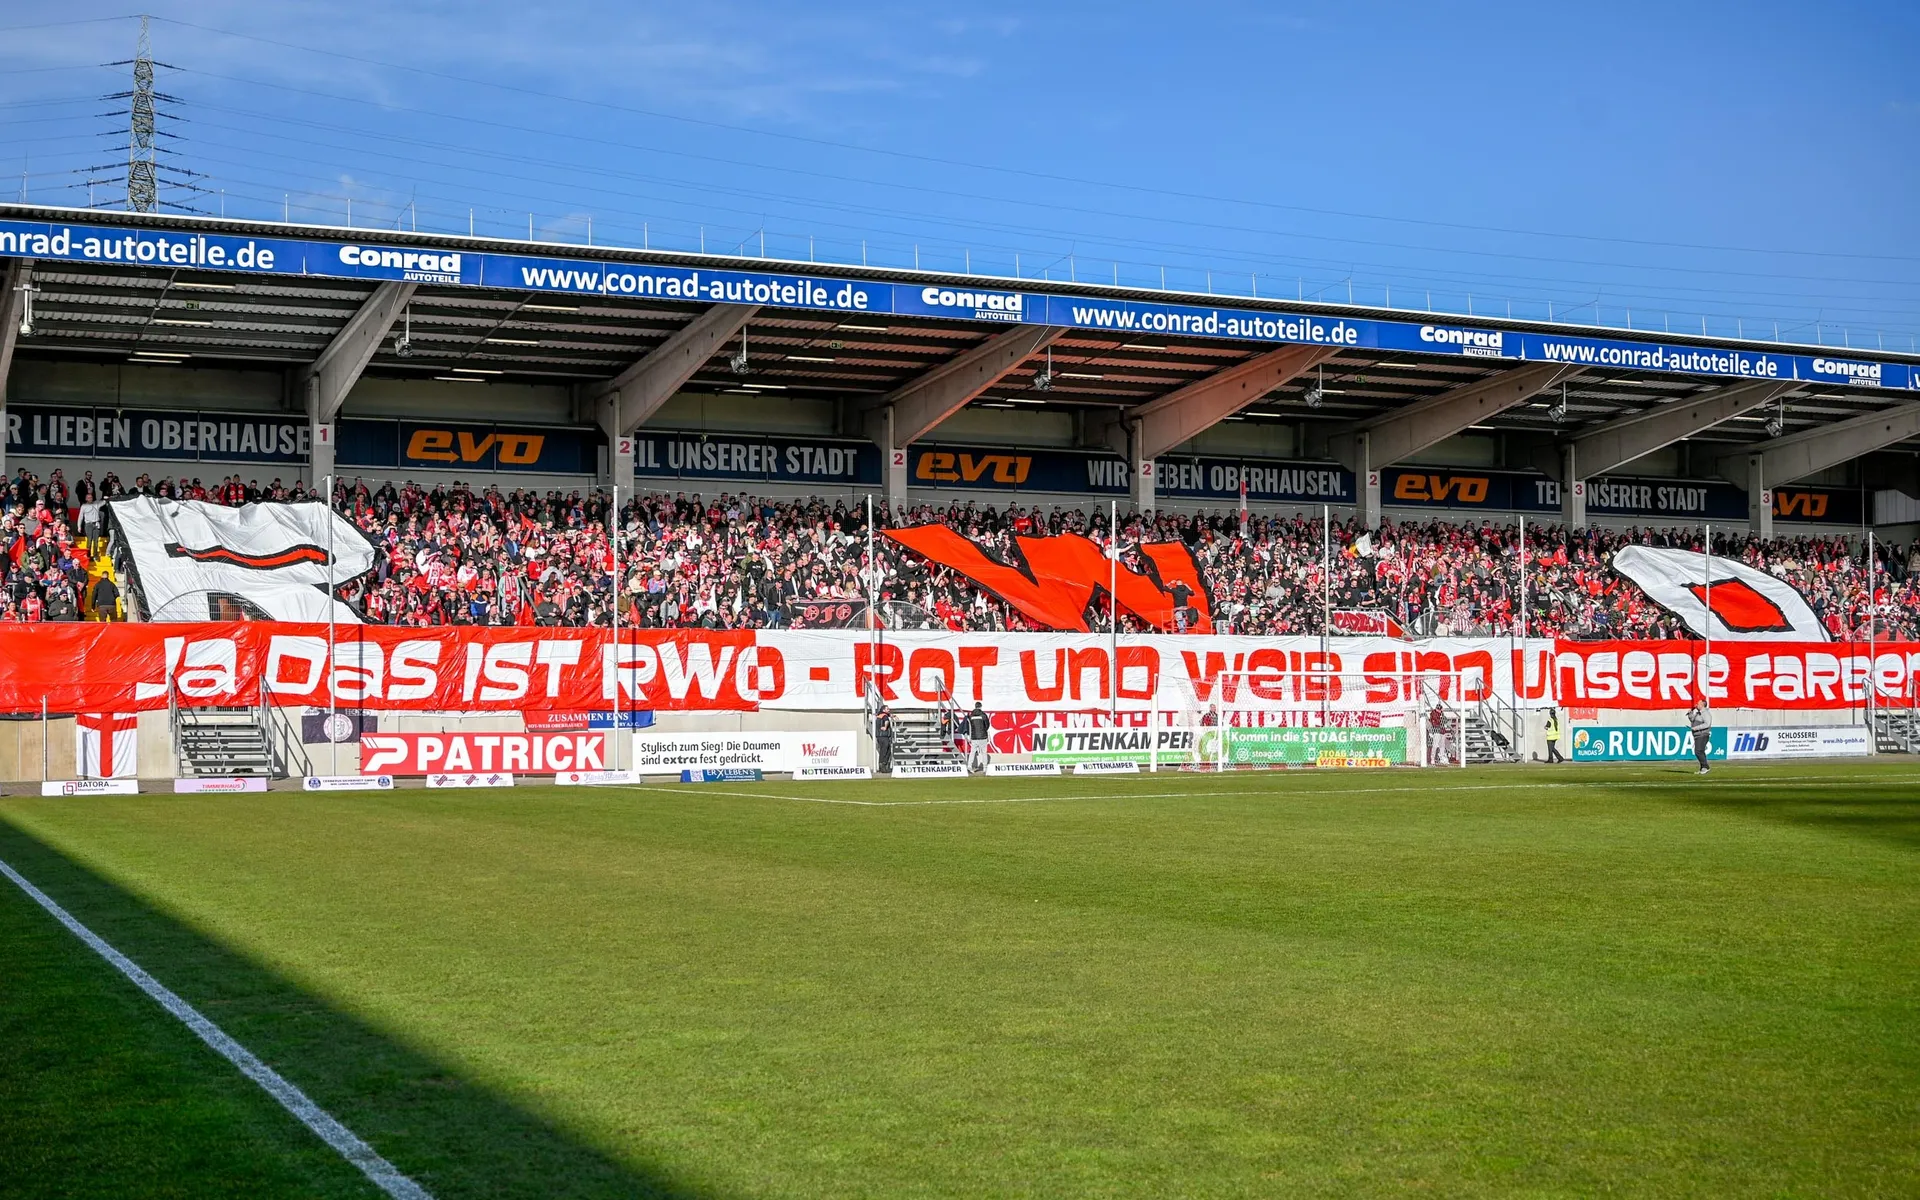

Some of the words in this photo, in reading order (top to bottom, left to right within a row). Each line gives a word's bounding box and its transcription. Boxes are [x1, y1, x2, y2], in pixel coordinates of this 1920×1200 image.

[339, 245, 461, 272] Conrad
[403, 272, 461, 284] AUTOTEILE
[521, 267, 868, 309] www.conrad-autoteile.de
[921, 287, 1022, 312] Conrad
[975, 311, 1022, 322] AUTOTEILE
[1072, 307, 1358, 345] www.conrad-autoteile.de
[1419, 326, 1503, 347] Conrad
[1463, 347, 1503, 357] AUTOTEILE
[1543, 343, 1778, 376] www.conrad-autoteile.de
[1812, 358, 1882, 378] Conrad
[1848, 378, 1882, 387] AUTOTEILE
[33, 414, 131, 449] LIEBEN
[141, 419, 310, 455] OBERHAUSE
[319, 427, 328, 441] 1
[406, 429, 545, 465] evo
[619, 440, 631, 454] 2
[668, 441, 778, 473] UNSERER
[785, 448, 857, 476] STADT
[893, 452, 904, 466] 2
[916, 452, 1032, 484] evo
[1087, 459, 1128, 487] WIR
[1211, 466, 1347, 496] OBERHAUSEN.
[1142, 463, 1152, 476] 2
[1369, 474, 1378, 486] 2
[1394, 474, 1490, 503] evo
[1575, 484, 1583, 496] 3
[1535, 480, 1561, 505] TEI
[1588, 484, 1652, 509] NSERER
[1657, 487, 1708, 512] STADT
[1762, 492, 1770, 504] 3
[1773, 492, 1829, 518] vo
[602, 641, 786, 702] RWO
[809, 667, 829, 681] -
[548, 712, 604, 722] ZUSAMMEN
[1231, 731, 1268, 742] Komm
[1270, 731, 1282, 742] in
[1282, 731, 1300, 742] die
[1302, 731, 1347, 743] STOAG
[1349, 731, 1396, 743] Fanzone!
[1733, 732, 1769, 752] ihb
[1778, 731, 1817, 740] SCHLOSSEREI
[417, 736, 604, 771] PATRICK
[641, 741, 677, 754] Stylisch
[680, 743, 699, 752] zum
[701, 741, 724, 753] Sieg!
[727, 741, 741, 751] Die
[743, 741, 781, 750] Daumen
[802, 743, 840, 757] Westfield
[641, 755, 661, 765] sind
[663, 755, 698, 765] extra
[700, 753, 717, 764] fest
[720, 753, 764, 766] gedrückt.
